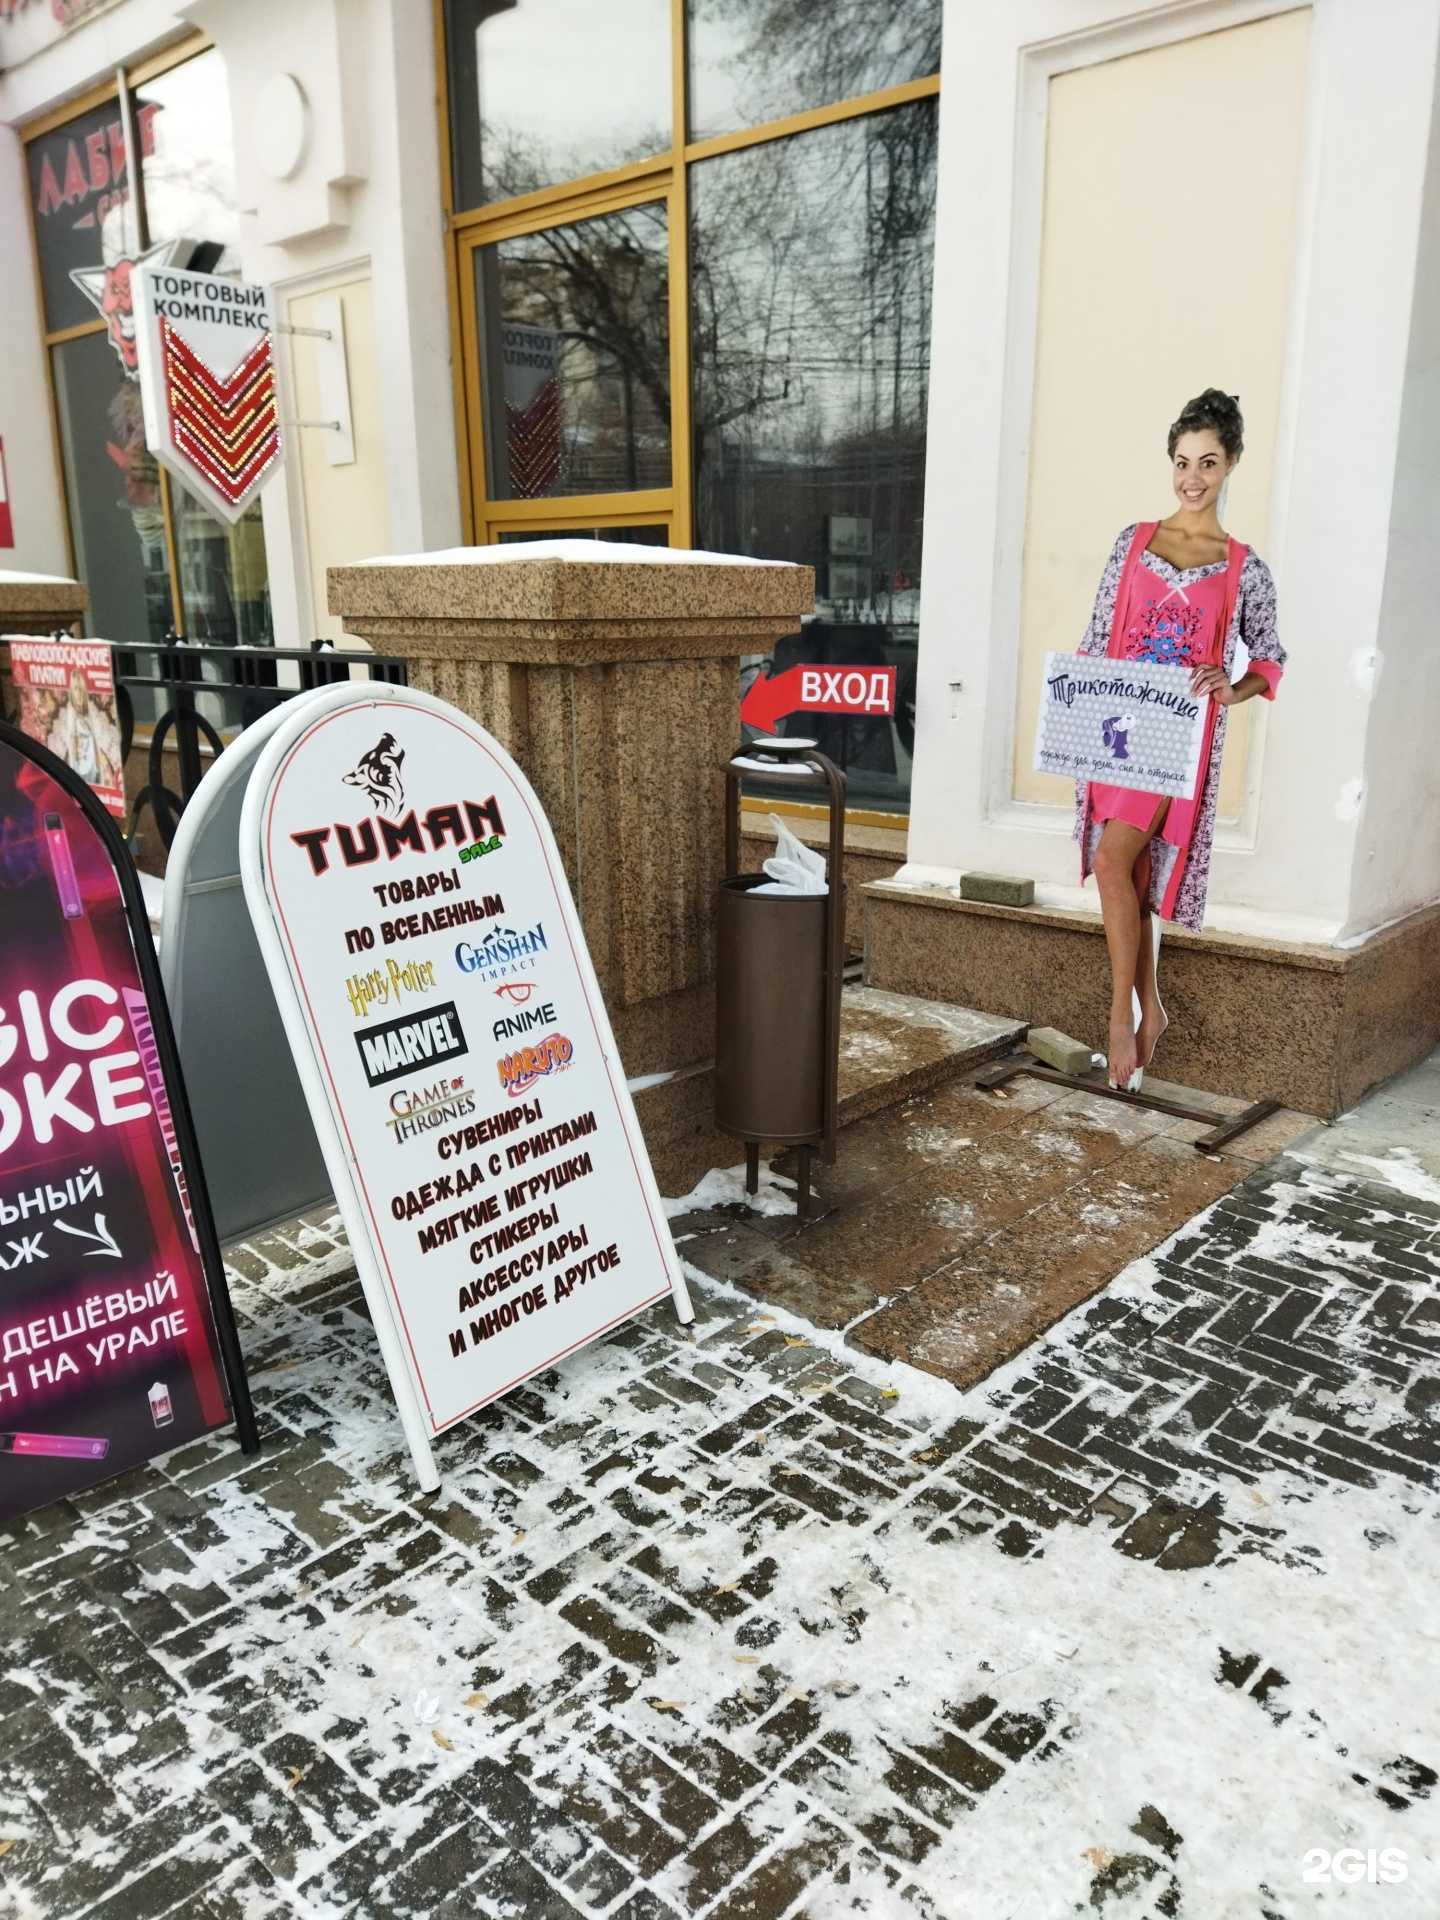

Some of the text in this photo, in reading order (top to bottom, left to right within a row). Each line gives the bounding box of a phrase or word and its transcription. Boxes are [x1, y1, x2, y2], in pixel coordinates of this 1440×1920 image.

[151, 274, 266, 307] ТОРГОВЫЙ
[154, 298, 270, 331] КОМПЛЕКС
[801, 671, 890, 712] ВХОД
[1047, 674, 1199, 720] Трикотажница
[290, 795, 506, 877] TUMAN
[459, 835, 503, 864] SALE
[373, 868, 461, 907] ТОВАРЫ
[344, 893, 505, 955] ПО ВСЕЛЕННЫМ
[345, 958, 437, 1017] Harry Potter
[481, 958, 537, 983] IMPACT
[0, 979, 124, 1067] IC
[493, 1003, 557, 1041] ANIME
[496, 1036, 573, 1090] NARUTO
[389, 1081, 450, 1117] GAME
[393, 1096, 476, 1144] THRONES
[437, 1098, 543, 1160] СУВЕНИРЫ
[390, 1111, 598, 1221] ОДЕЖДА С ПРИНТАМИ
[417, 1151, 594, 1254] МЯГКИЕ ИГРУШКИ
[469, 1203, 560, 1265] СТИКЕРЫ
[458, 1224, 589, 1313] АКСЕССУАРЫ
[2, 1270, 178, 1363] ДЕШЁВЫЙ
[448, 1243, 621, 1358] И МНОГОЕ ДРУГОЕ
[29, 1352, 80, 1389] НА
[86, 1310, 189, 1366] УРАЛЕ
